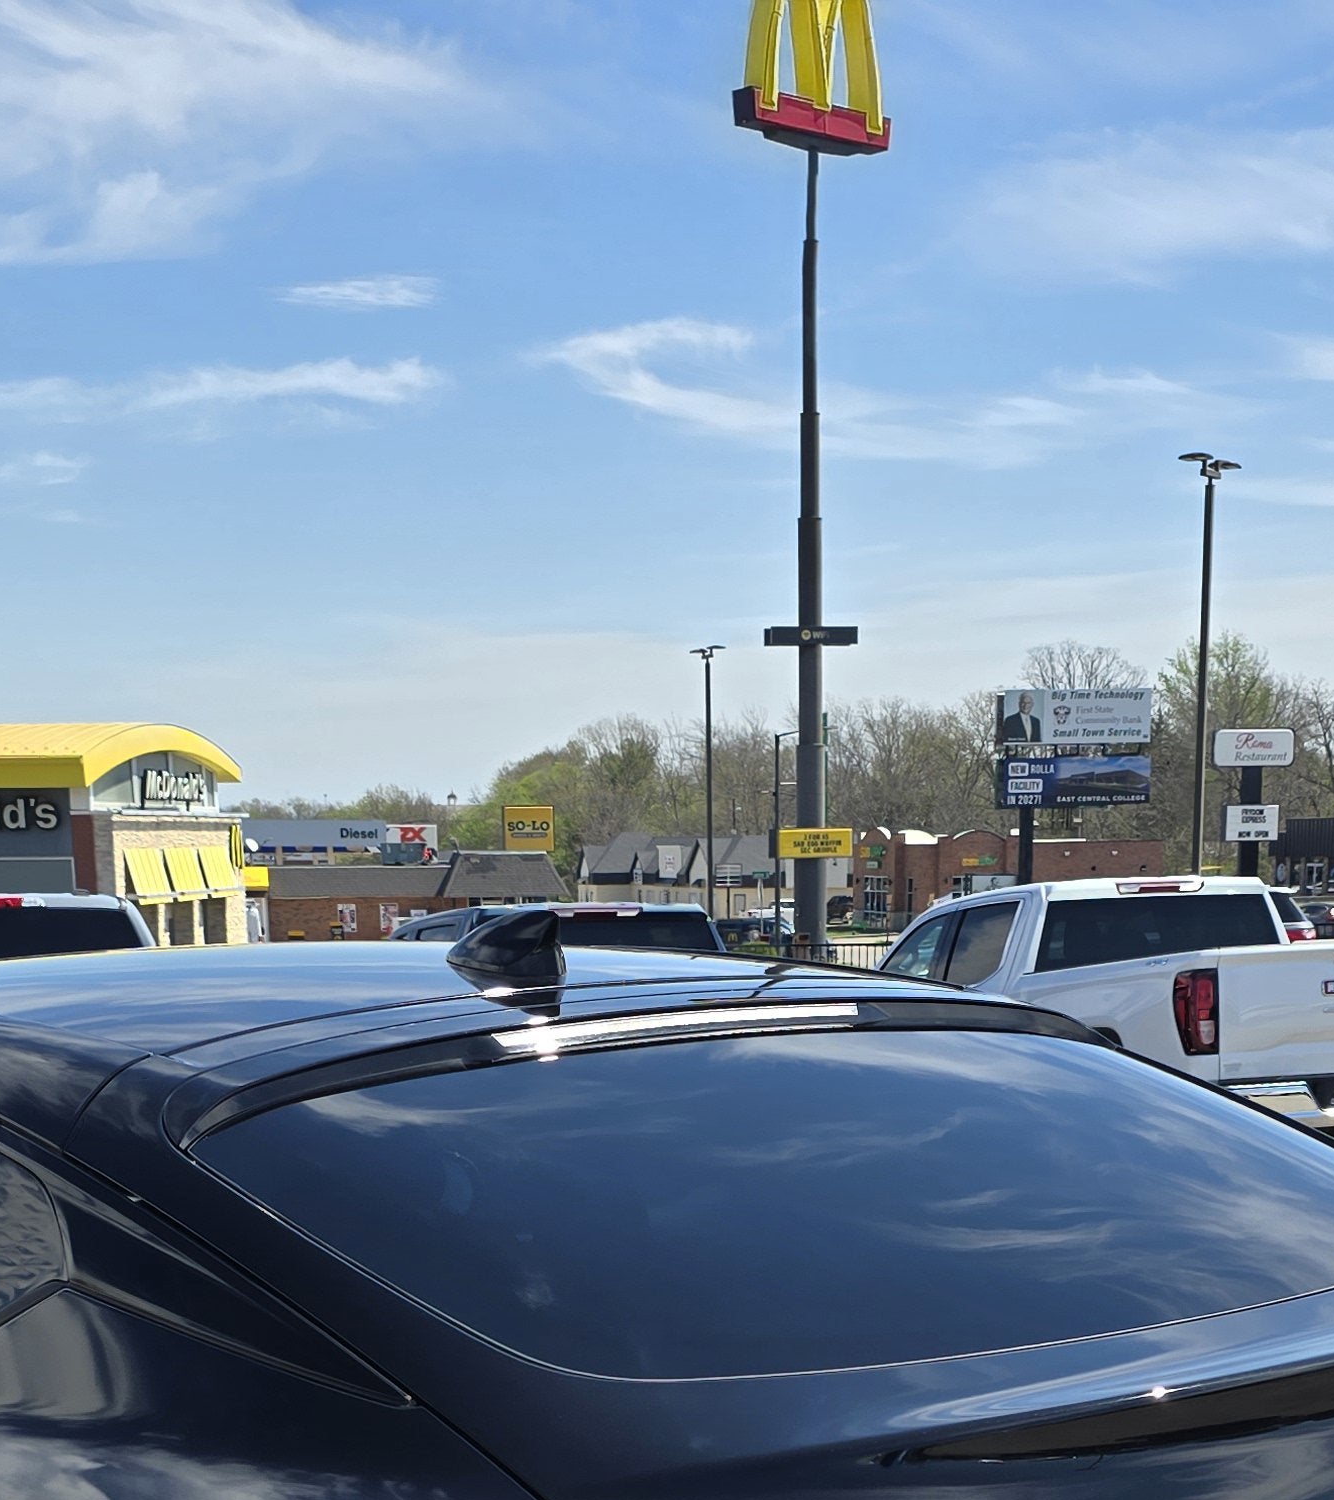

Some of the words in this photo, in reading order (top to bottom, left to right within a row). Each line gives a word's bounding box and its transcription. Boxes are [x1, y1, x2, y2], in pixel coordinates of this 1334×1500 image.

[1052, 690, 1067, 701] Big
[1070, 690, 1091, 699] Time
[1094, 690, 1145, 700] Technology
[1075, 706, 1093, 714] First
[1095, 706, 1114, 714] State
[1075, 716, 1120, 725] Community
[1122, 715, 1142, 724] Bank
[1052, 728, 1079, 738] Small
[1081, 728, 1105, 737] Town
[1108, 727, 1142, 737] Service
[1235, 733, 1273, 750] Roma
[1235, 751, 1288, 762] Restaurant
[1010, 765, 1027, 774] NEW
[1030, 764, 1055, 774] ROLLA
[1010, 781, 1041, 791] FACILITY
[1007, 795, 1016, 805] IN
[1056, 795, 1075, 803] EAST
[507, 821, 550, 831] SO-LO
[340, 828, 378, 839] Diesel
